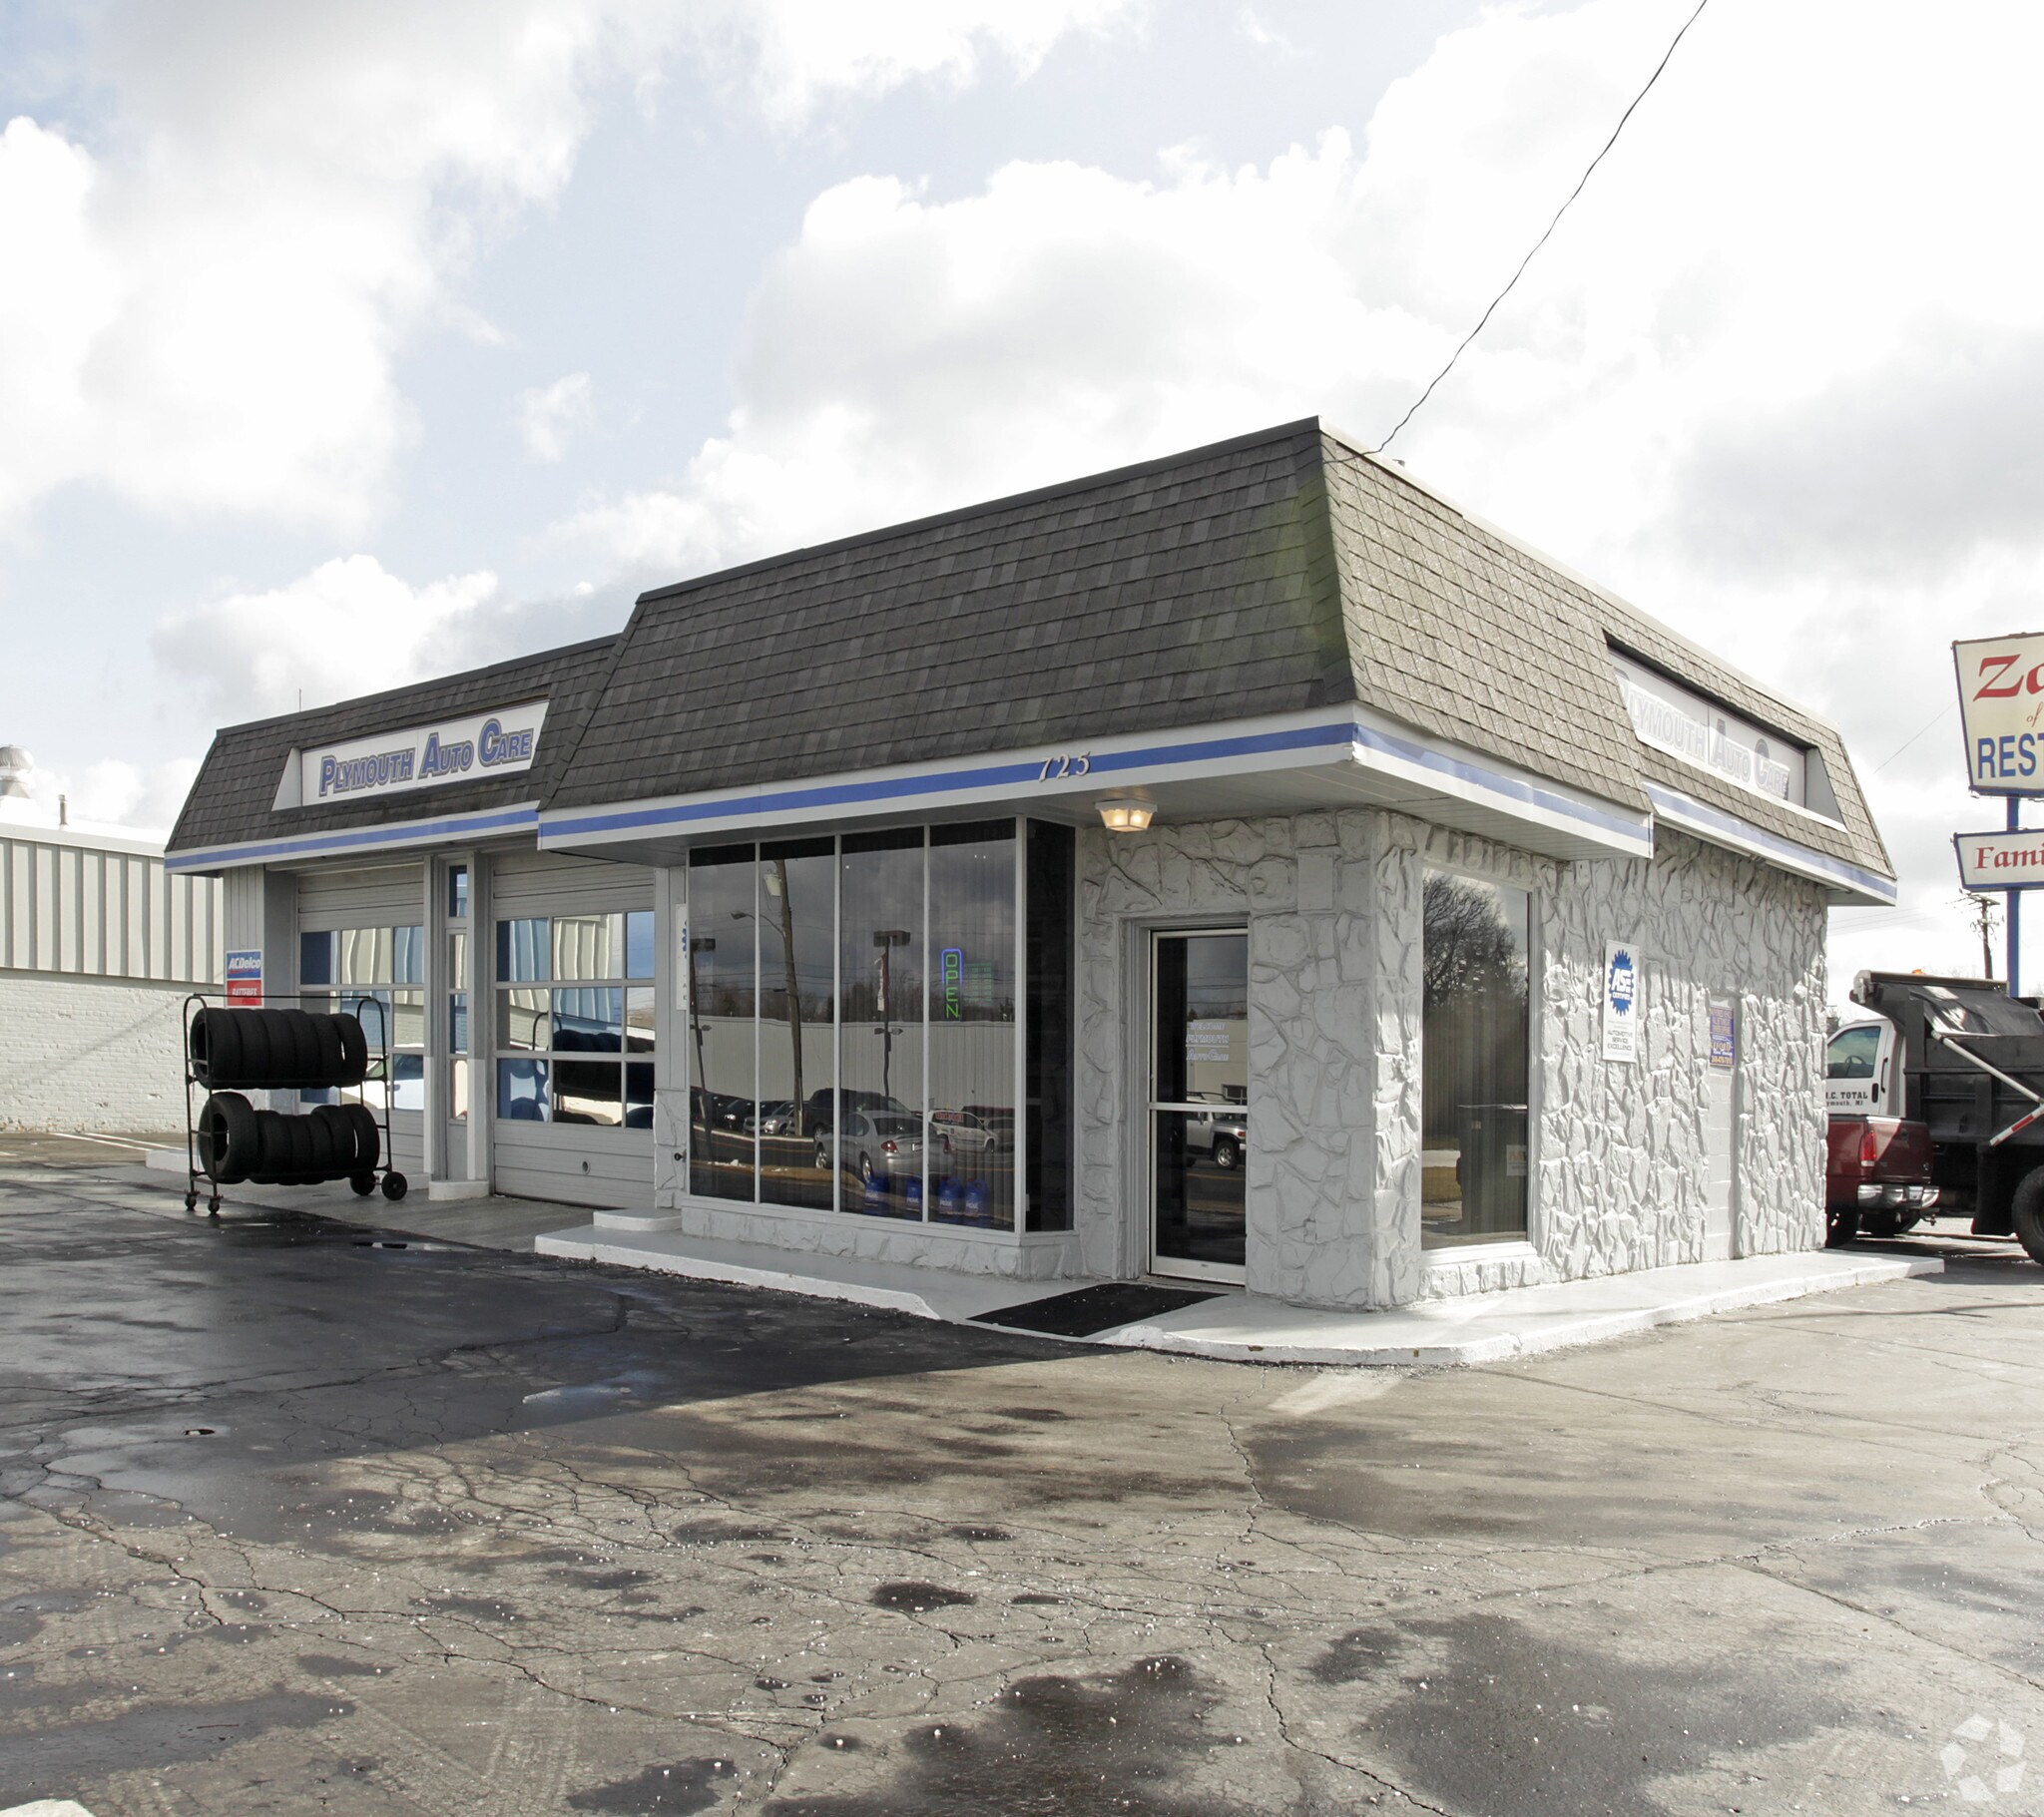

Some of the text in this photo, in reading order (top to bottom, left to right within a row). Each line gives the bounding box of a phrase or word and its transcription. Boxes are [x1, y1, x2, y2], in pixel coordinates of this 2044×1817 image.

[1038, 751, 1091, 782] 725
[229, 956, 261, 970] ACDelco
[945, 953, 959, 1019] OPEN
[1840, 1091, 1868, 1100] TOTAL
